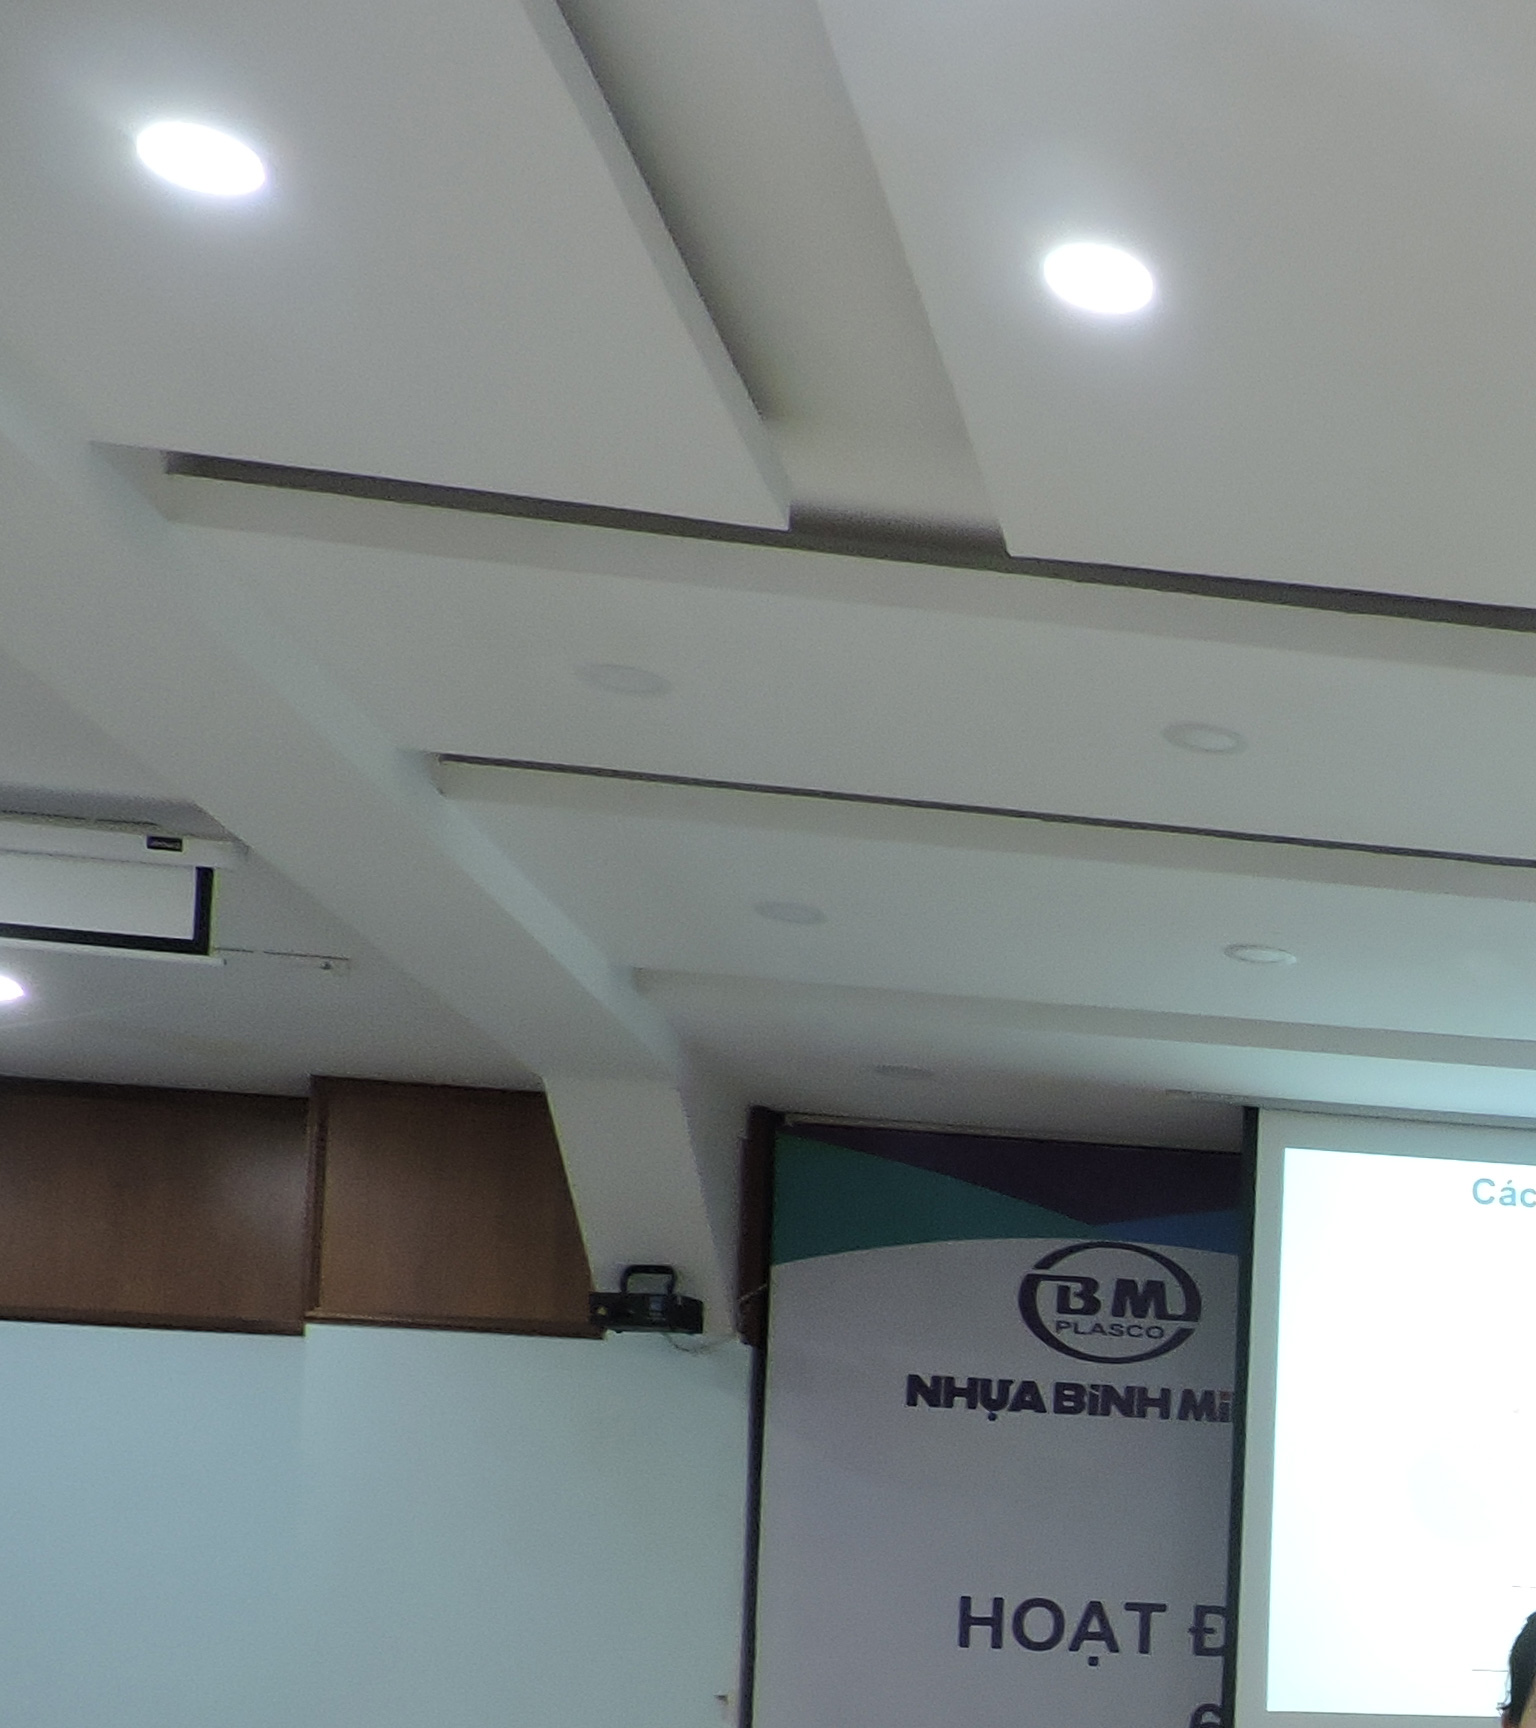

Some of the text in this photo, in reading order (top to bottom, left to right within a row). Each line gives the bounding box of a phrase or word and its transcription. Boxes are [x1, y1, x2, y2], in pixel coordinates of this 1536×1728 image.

[1056, 1320, 1165, 1340] PLASCO
[957, 1596, 1227, 1667] HOẠT Đ
